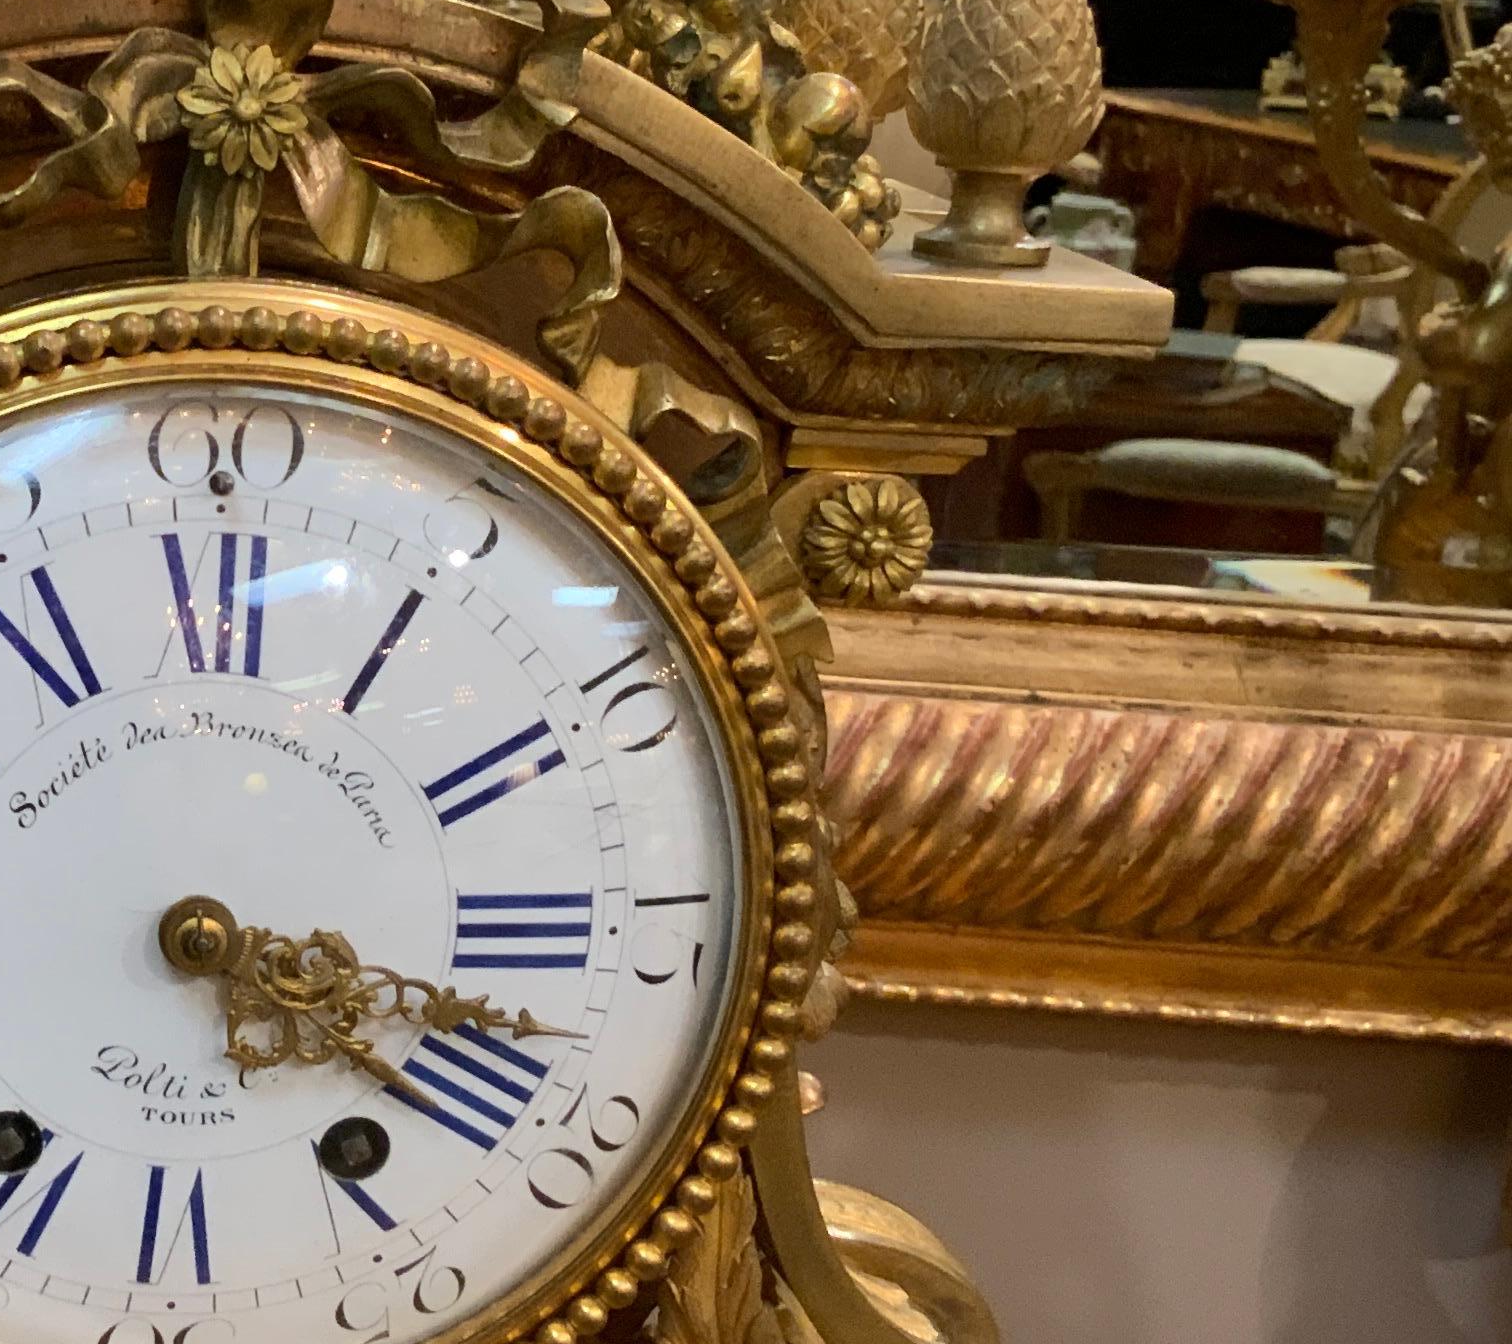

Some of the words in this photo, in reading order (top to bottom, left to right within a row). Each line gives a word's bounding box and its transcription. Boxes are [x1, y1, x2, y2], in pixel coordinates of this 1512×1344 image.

[148, 399, 304, 490] 60
[146, 532, 272, 679] XII
[575, 645, 679, 753] 10
[9, 736, 115, 829] Société
[180, 711, 315, 763] Bronzes
[338, 770, 394, 848] Paris
[419, 712, 568, 834] II
[451, 887, 592, 976] III
[630, 889, 711, 989] 15
[141, 1106, 236, 1126] TOURS
[527, 1082, 639, 1209] 20
[128, 1164, 221, 1287] VI
